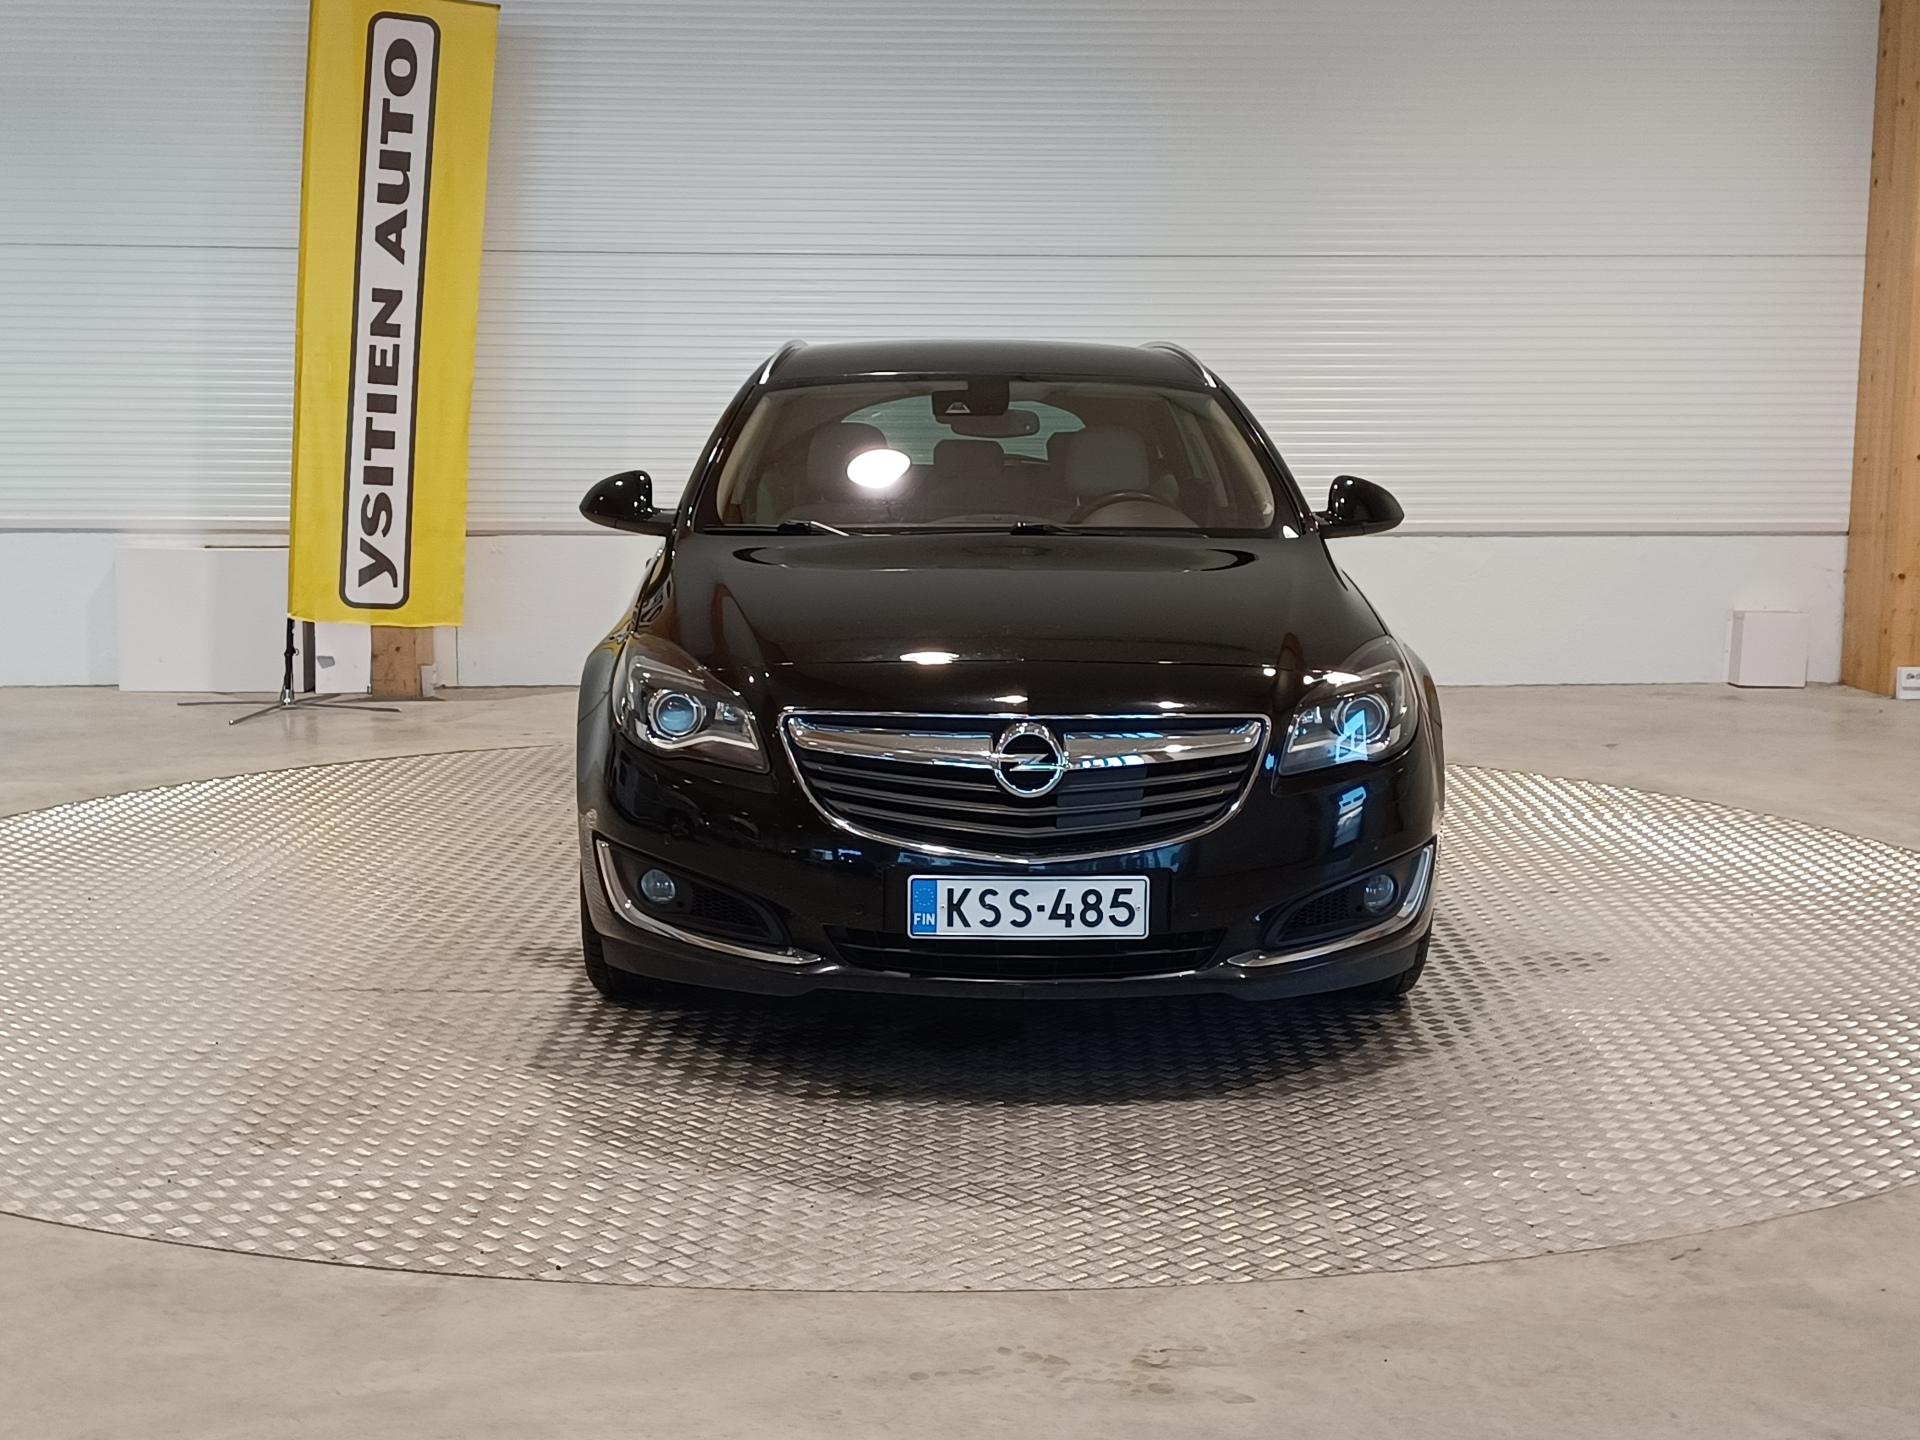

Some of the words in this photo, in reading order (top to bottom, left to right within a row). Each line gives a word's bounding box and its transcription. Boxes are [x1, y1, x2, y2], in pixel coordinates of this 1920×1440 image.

[374, 38, 418, 265] AUTO
[358, 287, 403, 588] YSITIEN
[913, 912, 936, 926] FIN
[946, 887, 1136, 928] KSS-485
